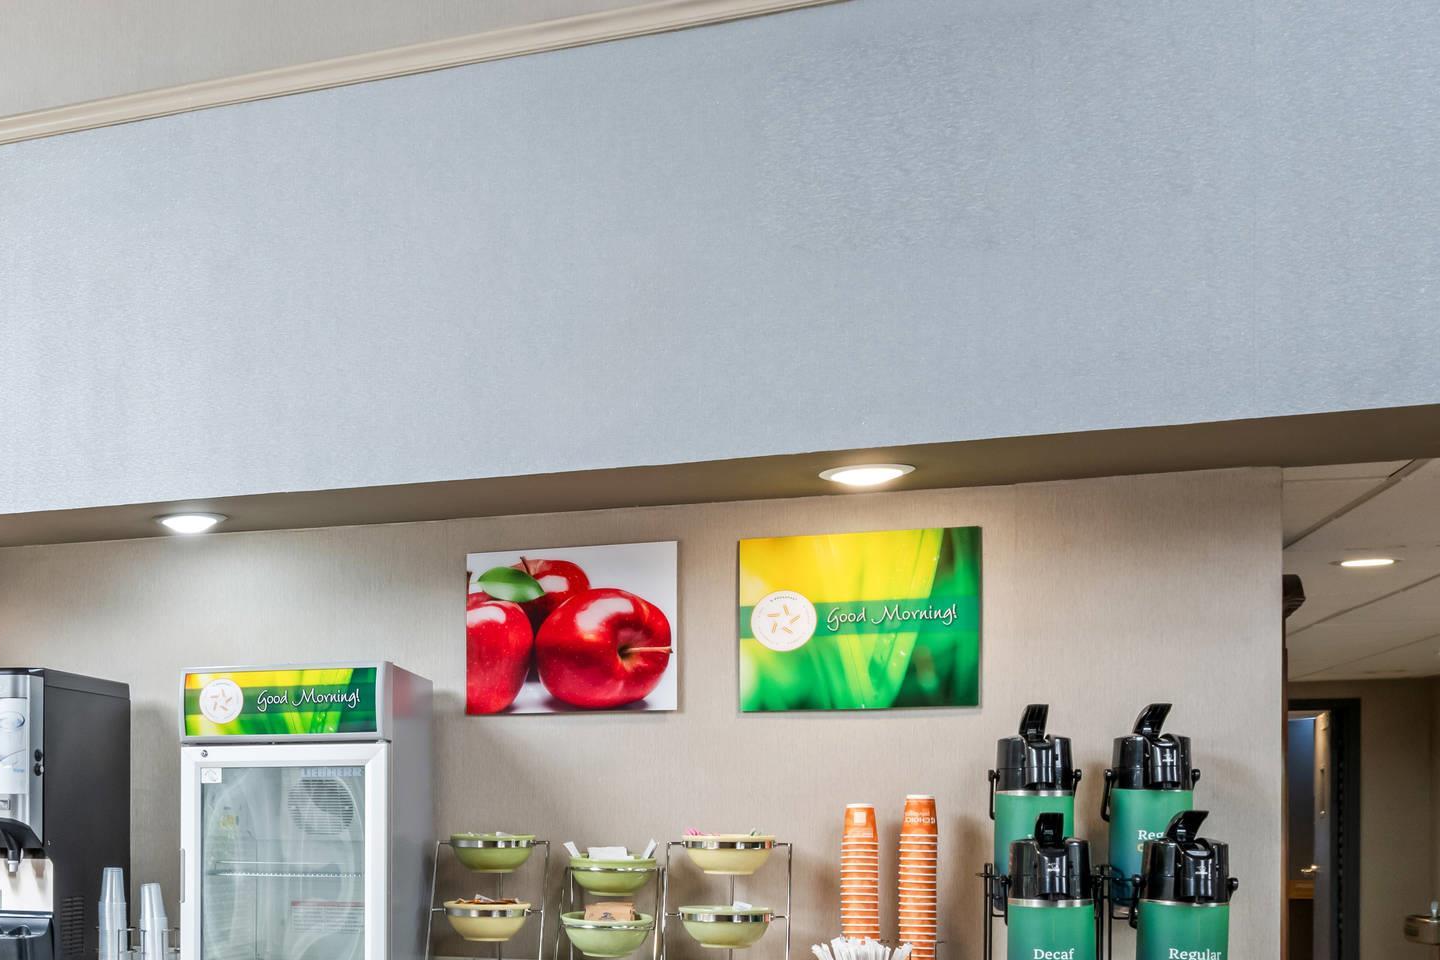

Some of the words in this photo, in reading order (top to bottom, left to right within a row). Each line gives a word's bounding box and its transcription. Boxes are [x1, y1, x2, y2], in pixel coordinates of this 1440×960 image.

[826, 607, 866, 632] Good
[871, 603, 958, 625] Morning!
[256, 689, 288, 712] Good
[291, 688, 361, 708] Morning!
[1033, 948, 1075, 960] Decaf
